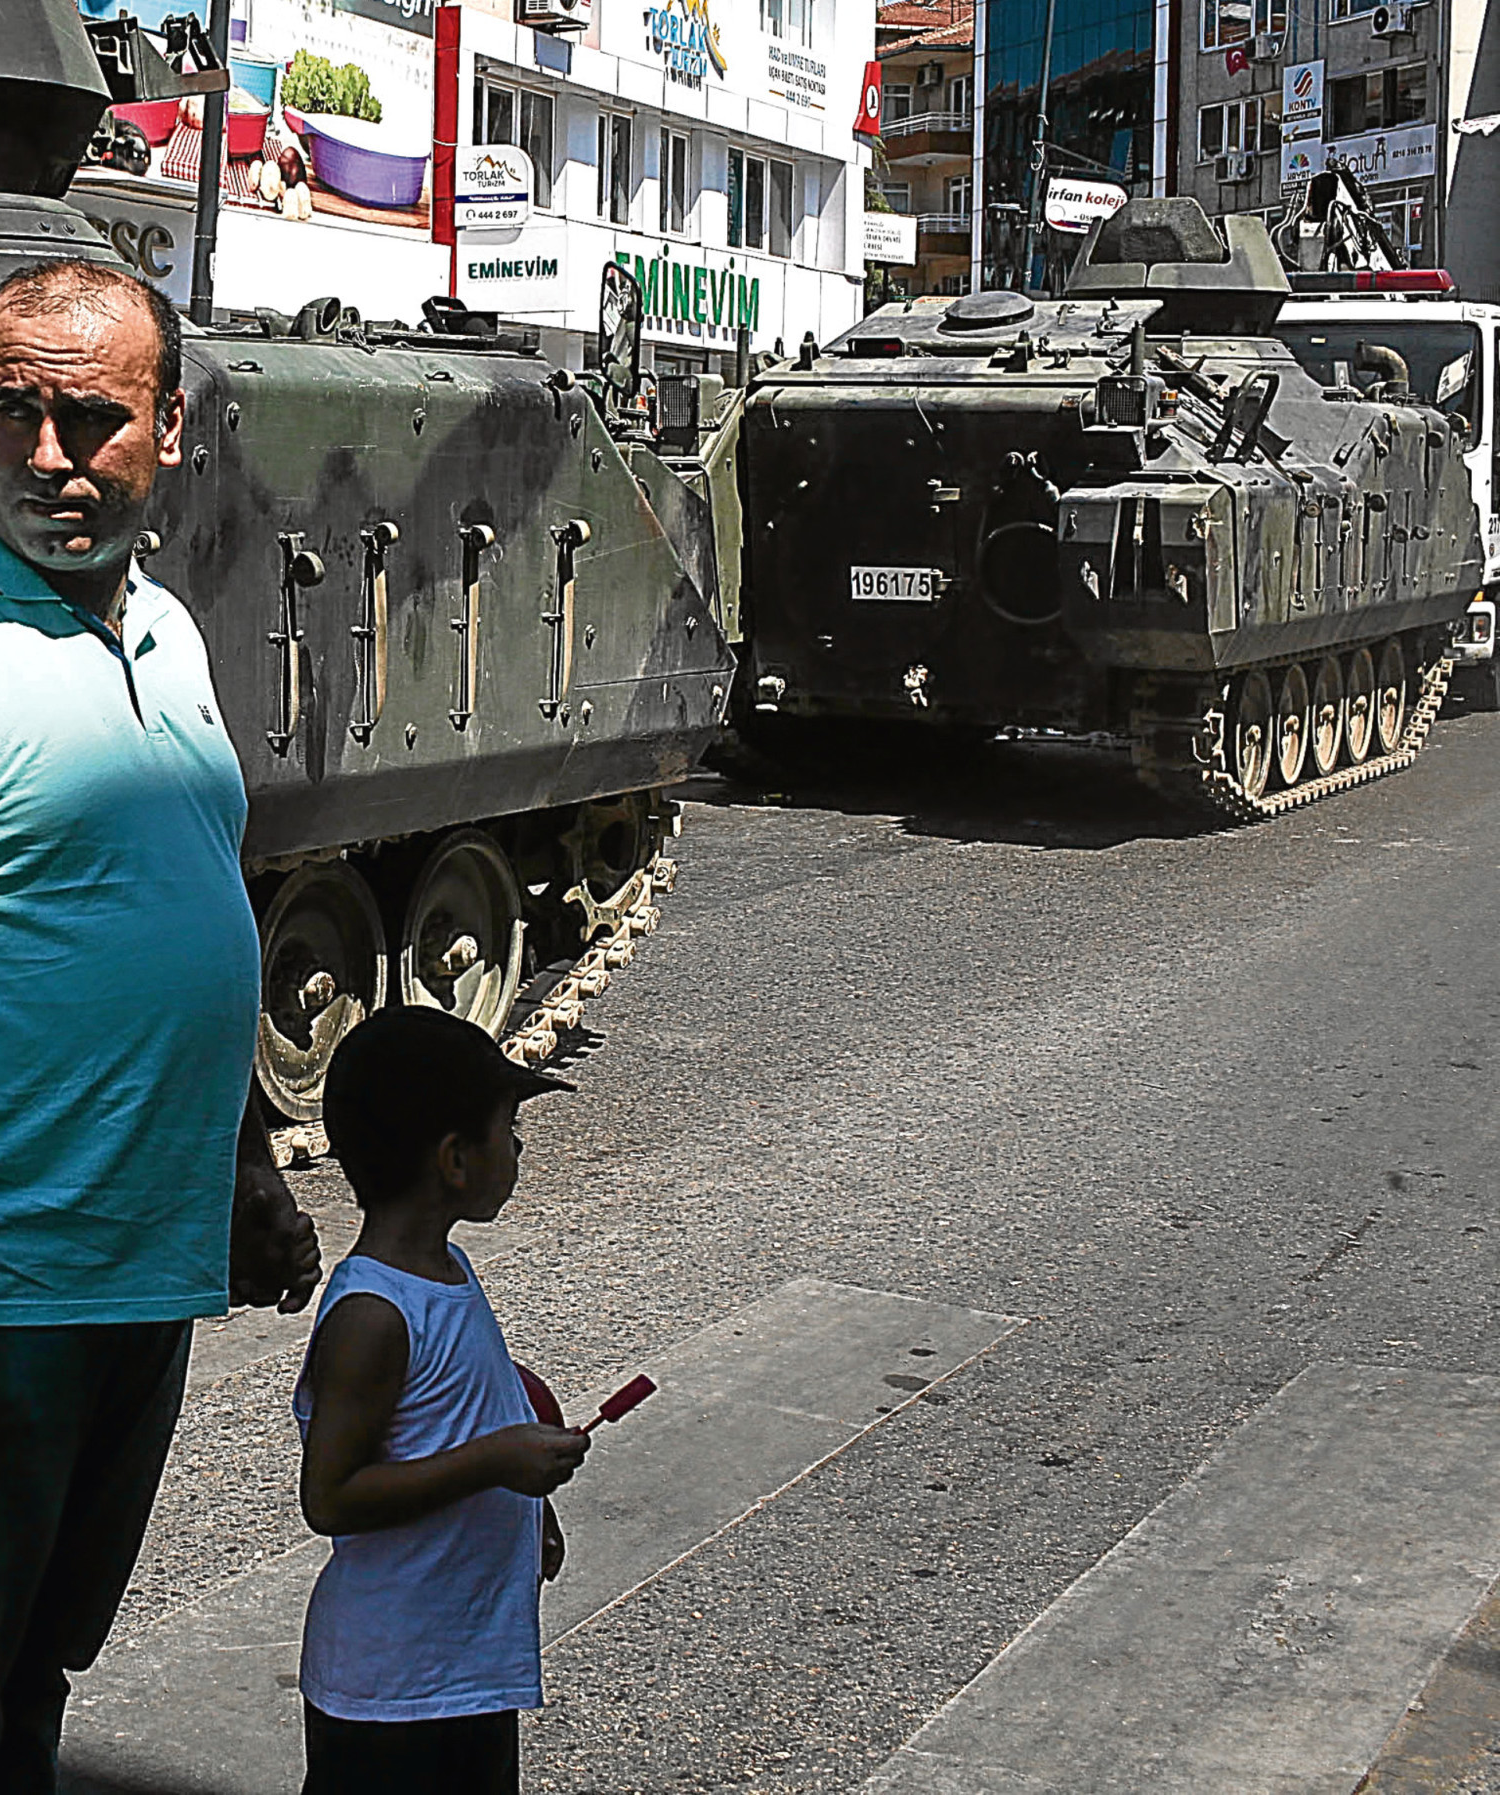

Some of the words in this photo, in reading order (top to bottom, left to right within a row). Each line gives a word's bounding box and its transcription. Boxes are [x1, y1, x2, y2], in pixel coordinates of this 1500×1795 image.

[649, 7, 707, 53] TORLAK
[1288, 98, 1317, 112] KONTV
[463, 170, 505, 182] TORLAK
[1048, 187, 1082, 203] irfan
[478, 211, 493, 220] 444
[495, 211, 501, 219] 2
[502, 210, 518, 219] 697
[468, 256, 558, 279] EMİNEVİM
[852, 572, 930, 596] 196175
